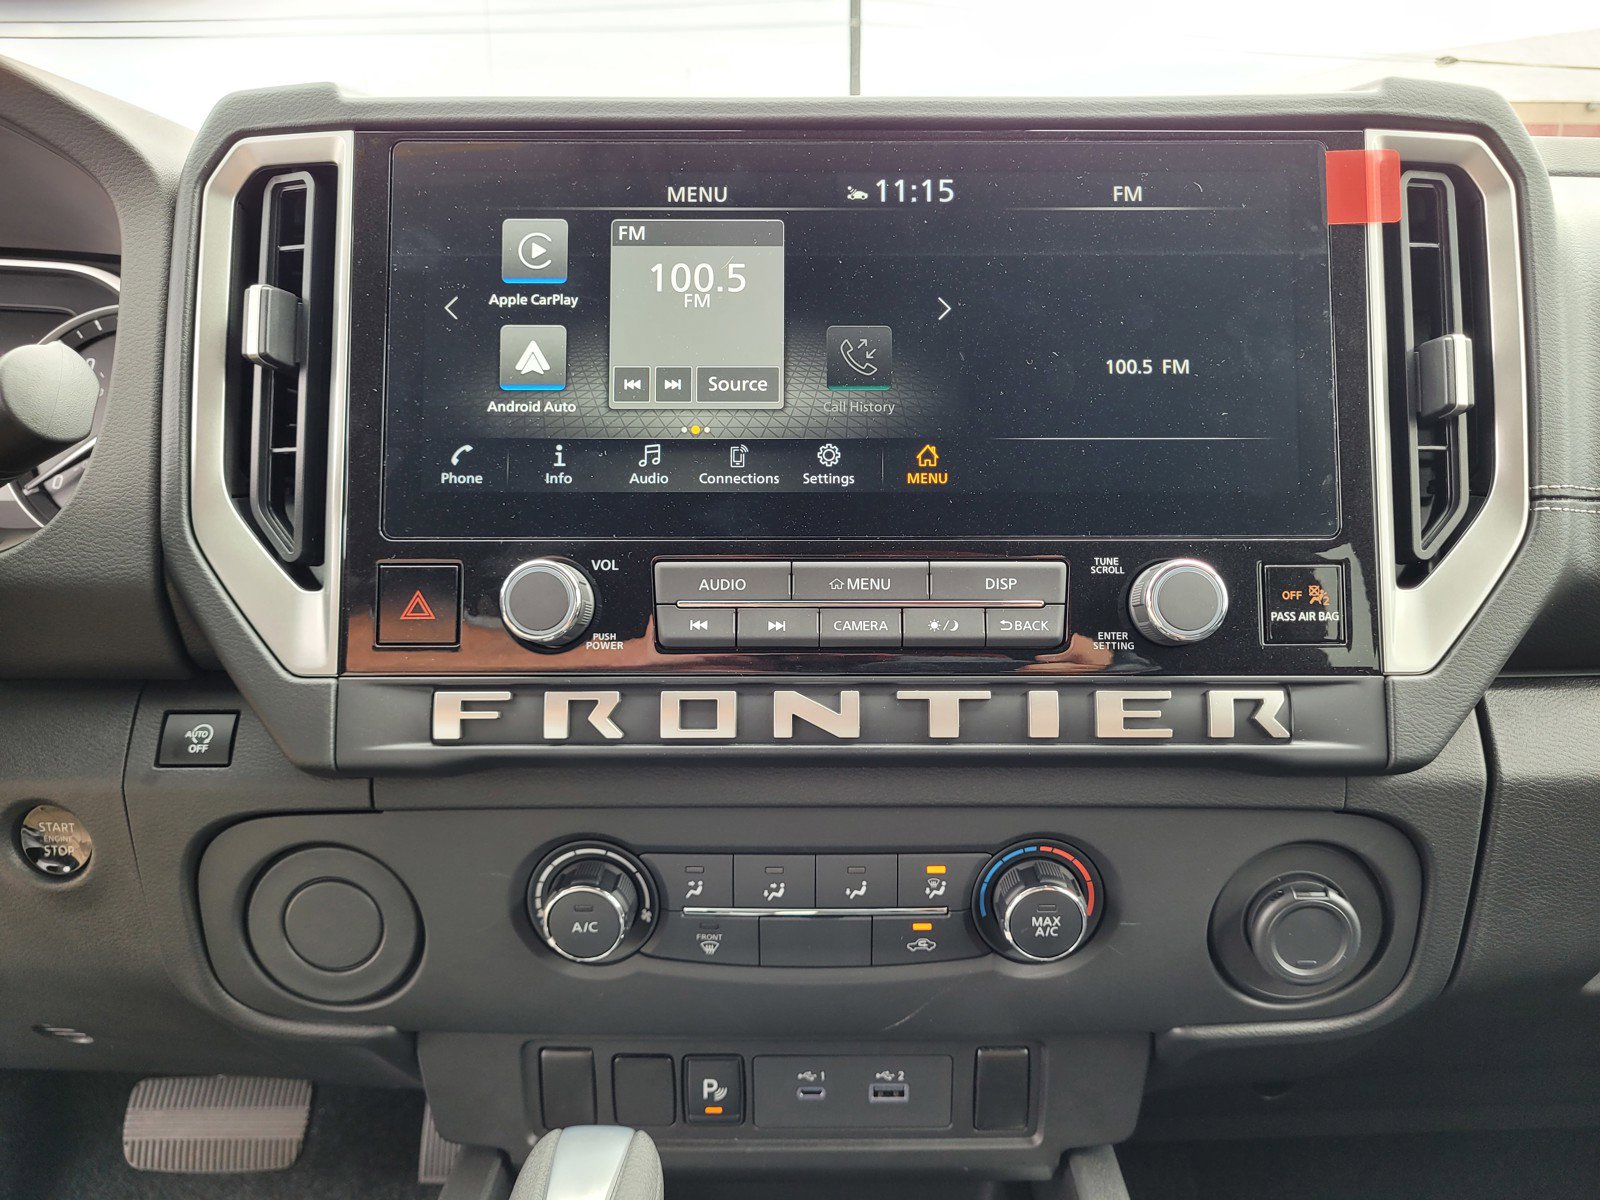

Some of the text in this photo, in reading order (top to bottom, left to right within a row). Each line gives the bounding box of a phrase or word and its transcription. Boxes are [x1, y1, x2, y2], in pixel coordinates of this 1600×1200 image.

[667, 186, 728, 203] MENU
[876, 178, 955, 203] 11:15
[1113, 185, 1143, 202] FM
[618, 225, 646, 242] FM
[650, 263, 747, 293] 100.5
[489, 294, 579, 308] Apple CarPlay
[683, 294, 711, 309] FM
[1106, 358, 1191, 375] 100.5 FM
[708, 376, 768, 393] Source
[487, 400, 577, 413] Android Auto
[823, 401, 896, 417] Call History
[441, 472, 484, 485] Phone
[545, 472, 573, 485] Info
[629, 472, 669, 485] Audio
[698, 472, 780, 485] Connections
[803, 472, 855, 487] Settings
[907, 472, 948, 485] MENU
[591, 559, 619, 571] VOL
[1093, 557, 1120, 566] TUNE
[1090, 566, 1125, 575] SCROLL
[698, 578, 747, 592] AUDIO
[846, 577, 892, 592] MENU
[984, 578, 1018, 591] DISP
[1281, 590, 1303, 601] OFF
[1270, 611, 1340, 622] PASS AIR BAG
[833, 619, 888, 632] CAMERA
[1014, 619, 1050, 632] BACK
[592, 632, 617, 641] PUSH
[1097, 631, 1129, 641] ENTER
[585, 641, 624, 651] POWER
[1092, 641, 1135, 650] SETTING
[433, 690, 1291, 739] FRONTIER
[184, 730, 208, 739] AUTO
[187, 743, 209, 754] OFF
[38, 821, 75, 833] START
[43, 844, 75, 857] STOP
[571, 920, 599, 933] A/C
[1031, 916, 1062, 928] MAX
[696, 933, 723, 941] FRONT
[1034, 926, 1059, 938] A/C
[897, 1070, 905, 1082] 2
